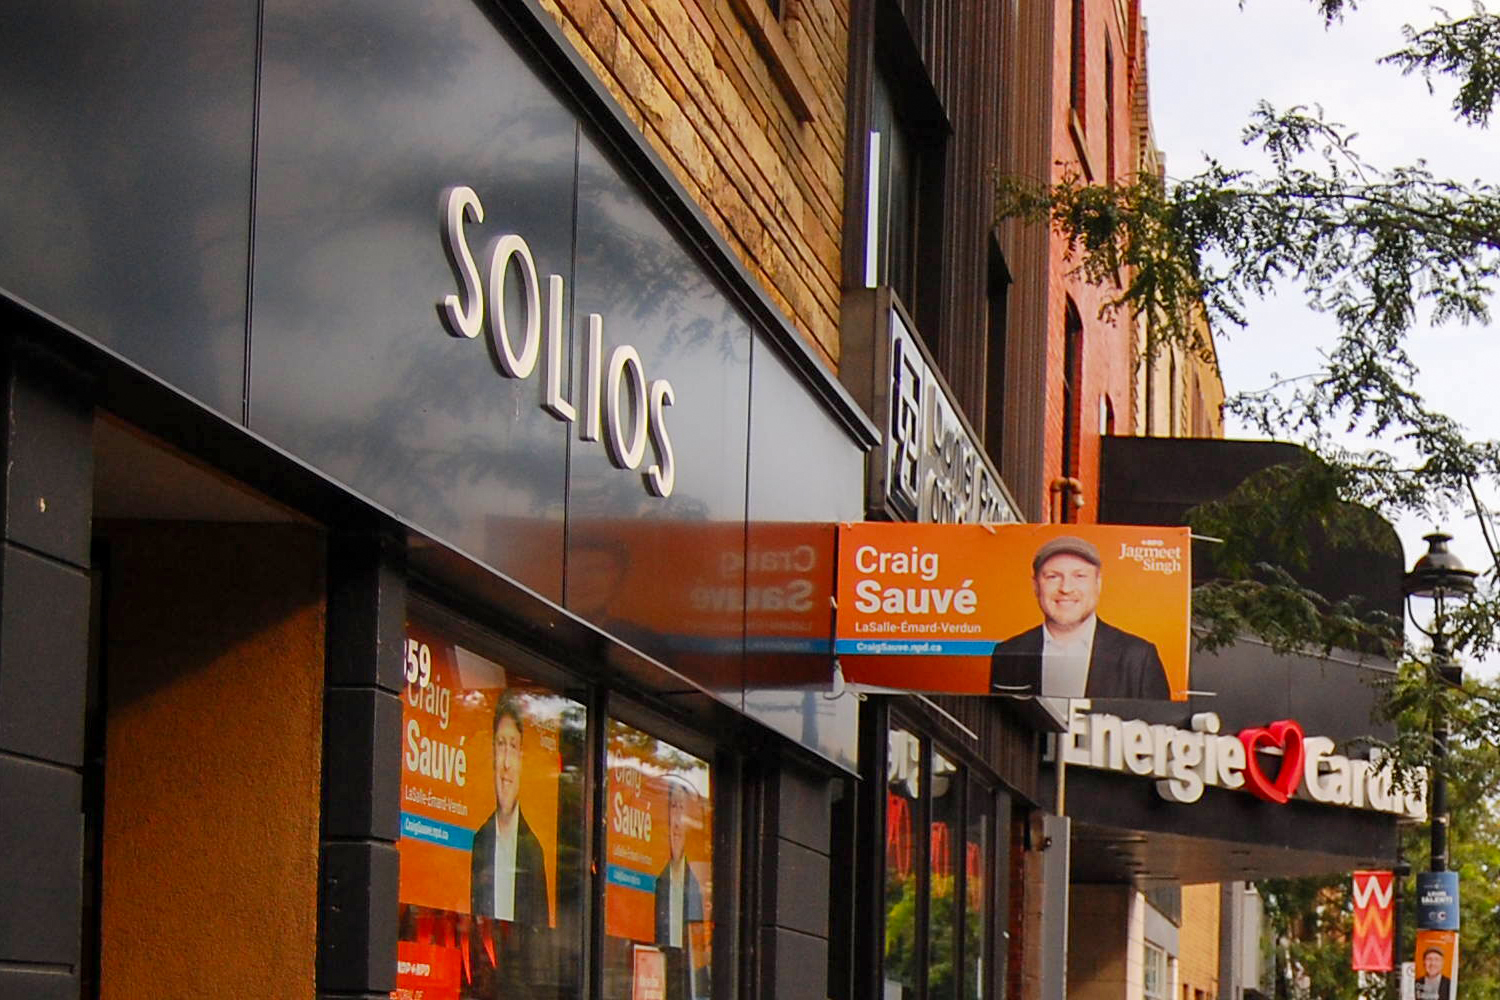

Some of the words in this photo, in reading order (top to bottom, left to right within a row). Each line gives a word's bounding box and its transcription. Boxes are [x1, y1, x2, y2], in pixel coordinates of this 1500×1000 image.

[442, 185, 676, 498] SOLIOS
[855, 545, 939, 581] Craig
[1118, 544, 1181, 562] Jagmeet
[1142, 559, 1181, 575] Singh
[855, 579, 978, 614] Sauvé
[855, 620, 982, 634] LaSalle-Émard-Verdun
[403, 638, 431, 688] 59
[406, 720, 467, 788] Sauvé
[613, 792, 653, 842] Sauvé
